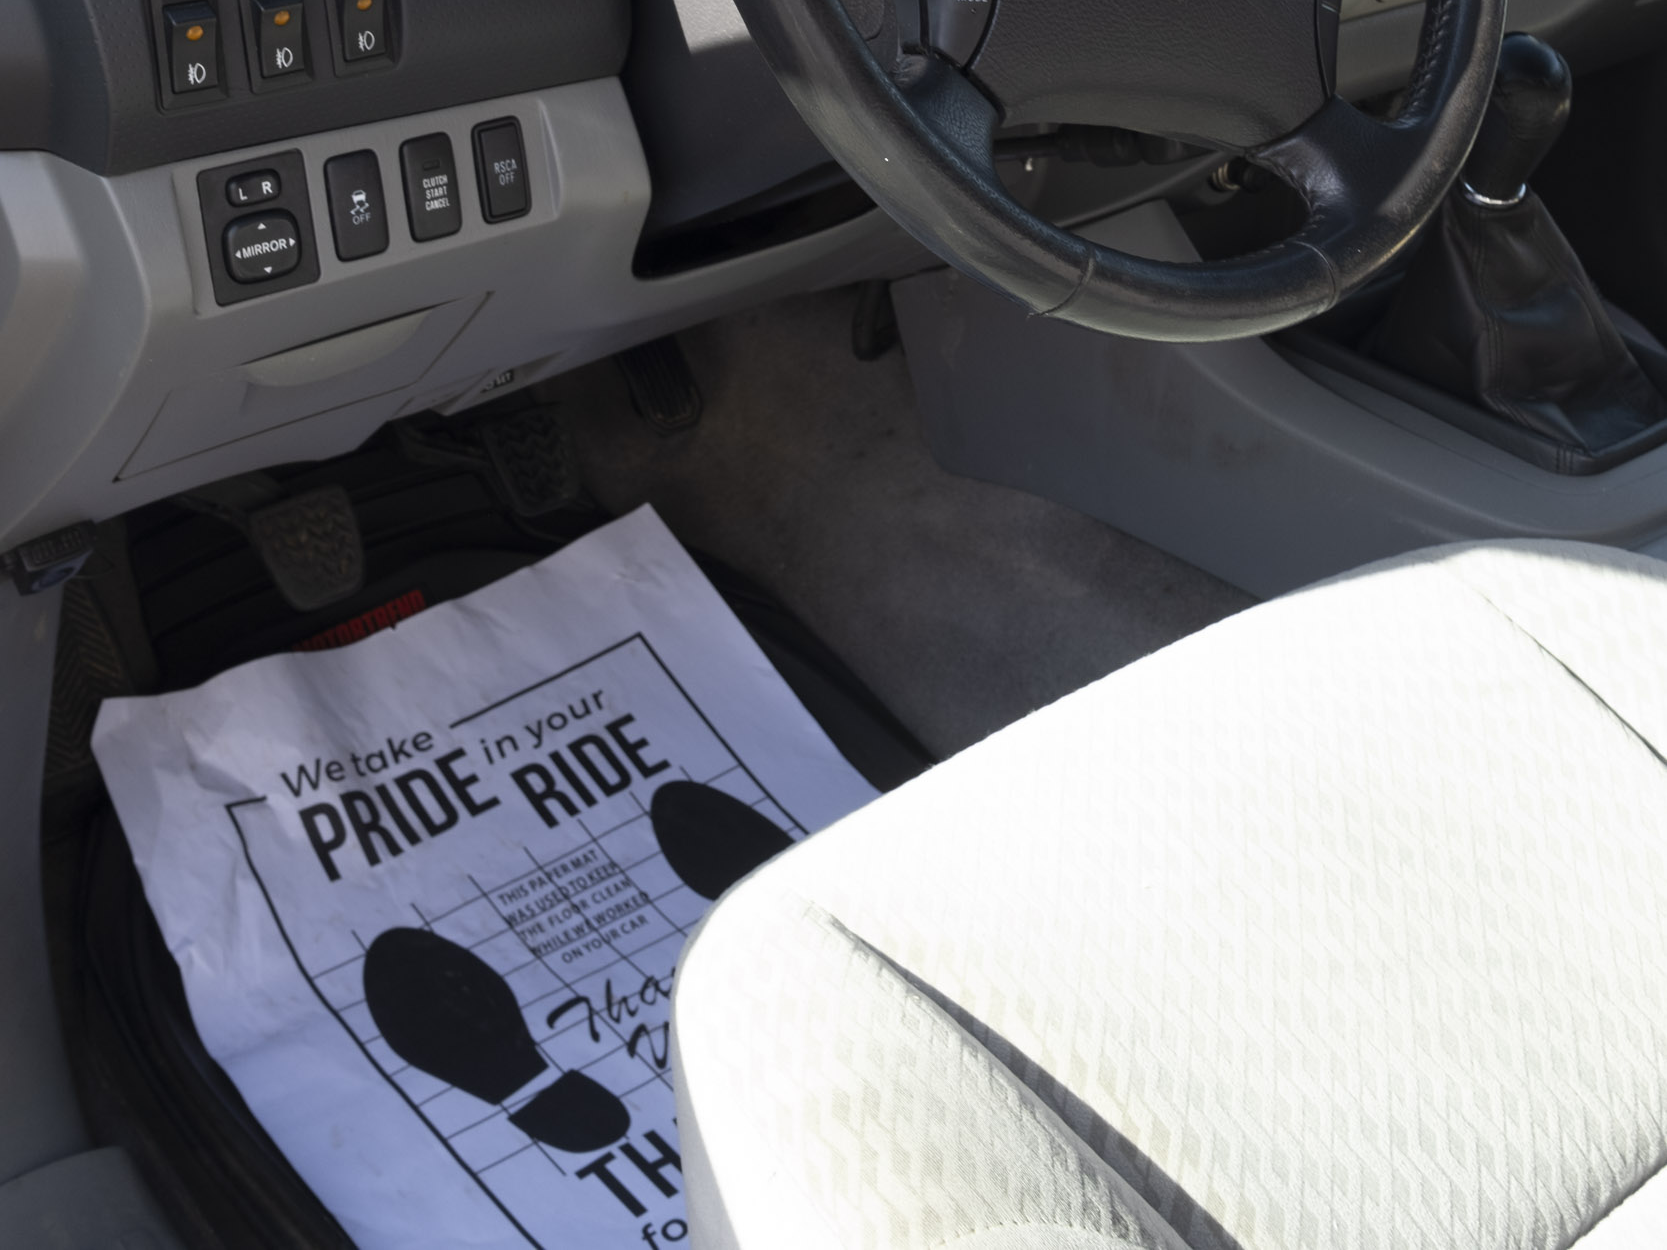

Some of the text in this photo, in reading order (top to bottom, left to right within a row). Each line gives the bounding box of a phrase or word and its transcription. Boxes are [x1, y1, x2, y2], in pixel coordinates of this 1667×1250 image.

[239, 181, 273, 201] L R
[422, 174, 448, 189] CLUTCH
[493, 158, 518, 175] RSCA
[499, 171, 516, 186] OFF
[425, 185, 447, 200] START
[425, 198, 450, 211] CANCEL
[352, 212, 371, 225] OFF
[242, 238, 288, 259] MIRROR
[479, 690, 605, 765] in your
[280, 731, 434, 798] We take
[299, 713, 671, 882] PRIDE RIDE
[498, 849, 600, 906] THIS PAPER MAT
[506, 862, 619, 928] WAS USED TO KEEP
[518, 877, 633, 941] THE FLOOR CLEAN
[532, 891, 650, 956] WHILE WE WORKED
[561, 914, 649, 964] ON YOUR CAR
[546, 966, 676, 1043] Tha
[575, 1116, 683, 1217] TH
[640, 1218, 689, 1250] fo
